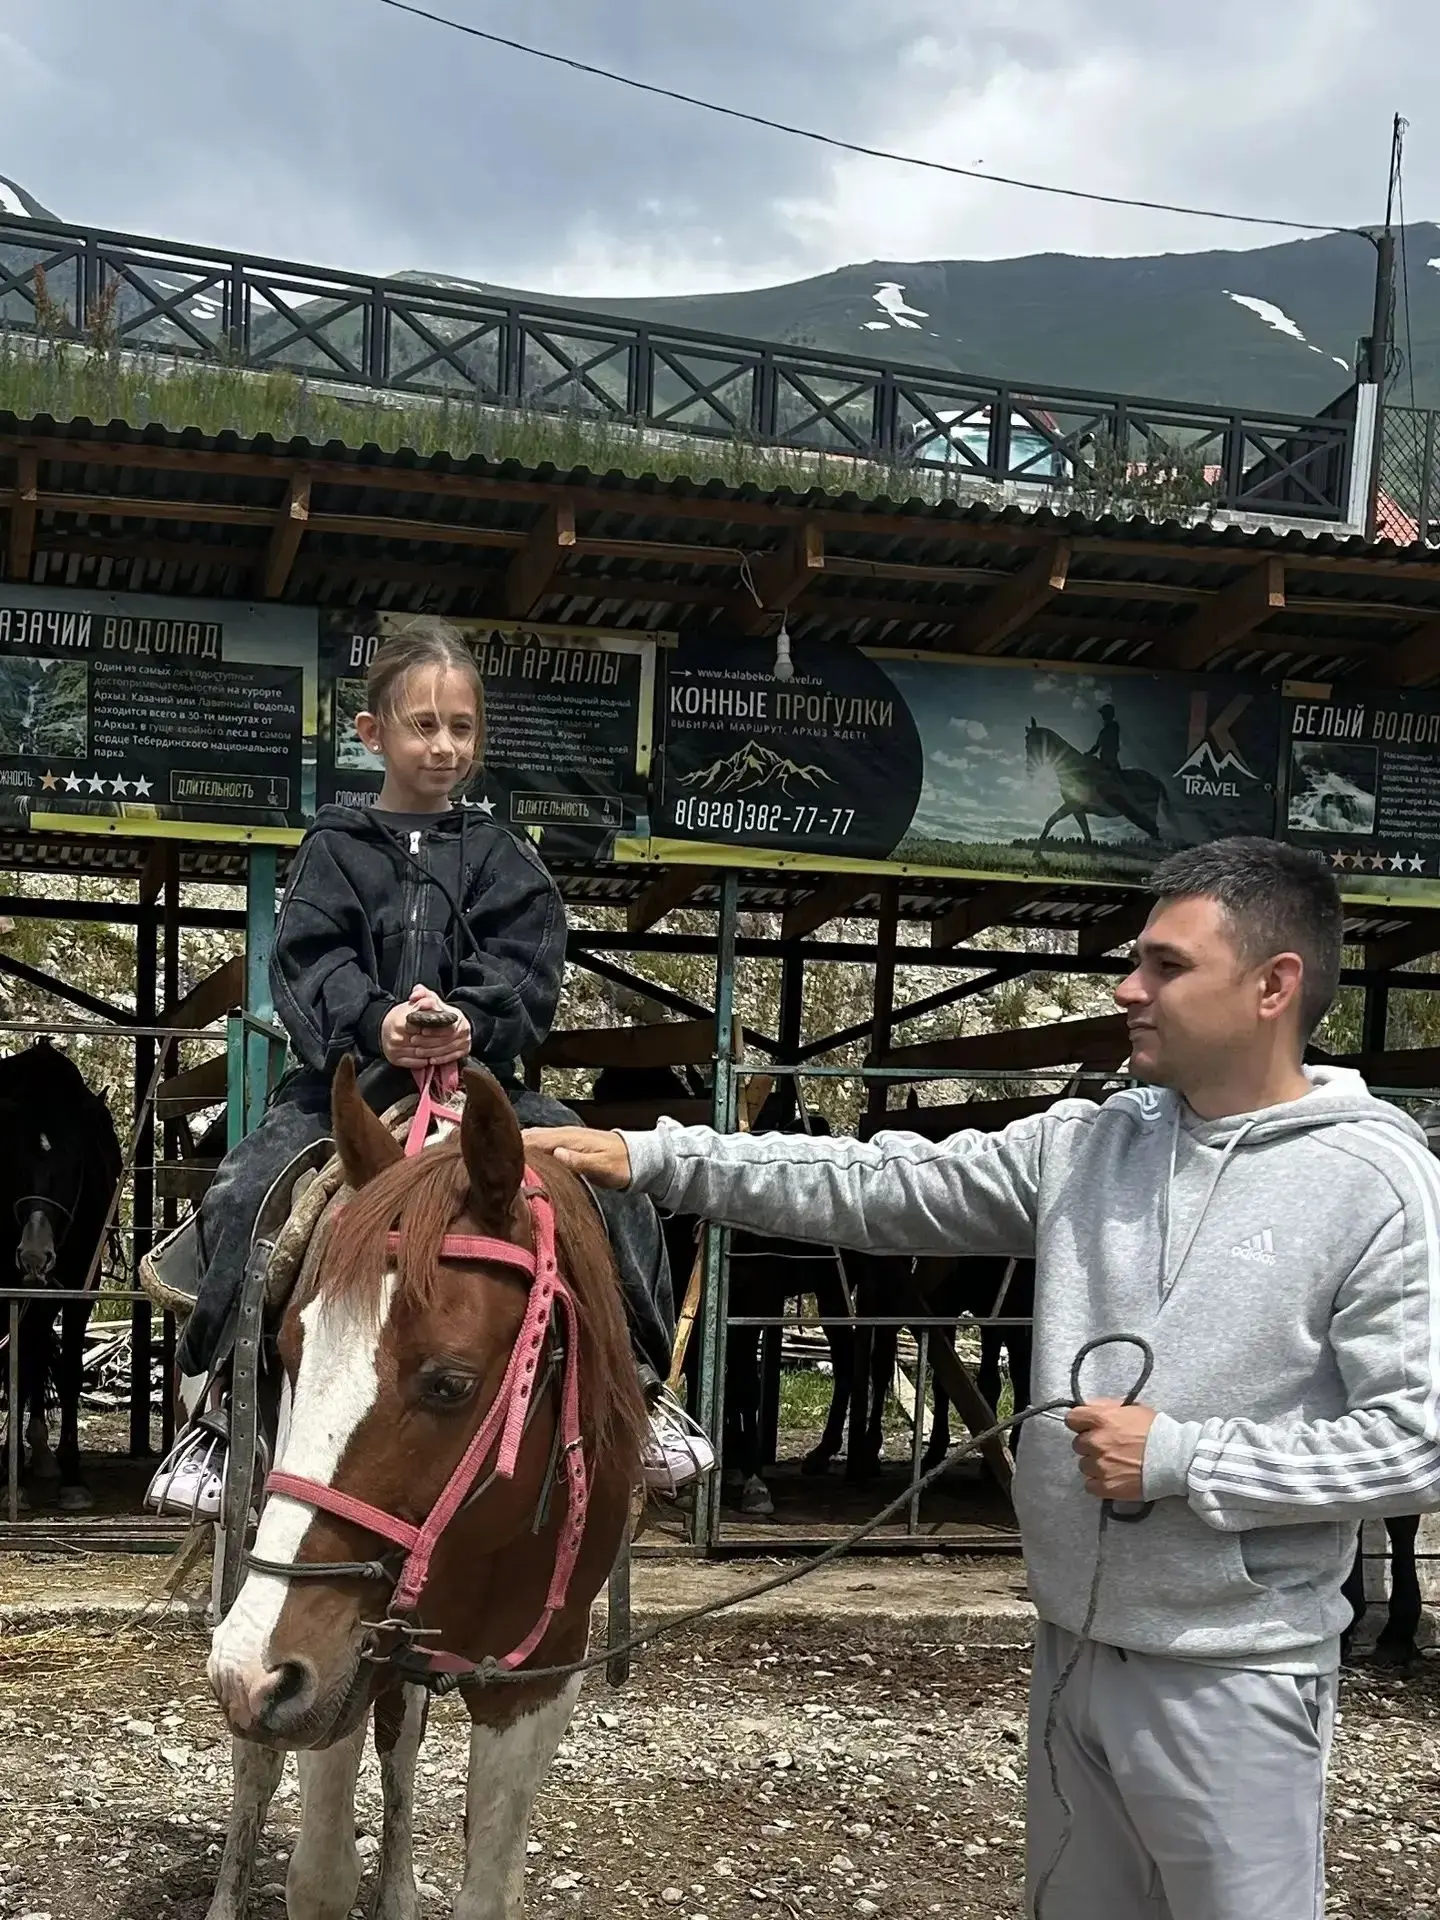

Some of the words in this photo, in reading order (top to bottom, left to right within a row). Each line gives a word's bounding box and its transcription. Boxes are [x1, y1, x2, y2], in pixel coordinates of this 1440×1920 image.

[103, 617, 218, 659] ВОДОПАД
[94, 661, 121, 673] Один
[124, 666, 136, 674] из
[139, 667, 171, 677] самых
[131, 692, 174, 704] Казачий
[176, 697, 197, 706] или
[253, 701, 297, 714] водопад
[227, 686, 241, 695] на
[242, 687, 283, 699] курорте
[93, 706, 148, 718] находится
[149, 709, 177, 720] всего
[179, 711, 186, 719] в
[217, 713, 260, 726] минутах
[261, 716, 274, 725] от
[671, 685, 769, 719] КОННЫЕ
[775, 691, 894, 728] ПРОГУЛКИ
[671, 719, 725, 731] ВЫБИРАЙ
[792, 727, 828, 738] АРХЫЗ
[1292, 703, 1365, 739] БЕЛЫЙ
[140, 723, 148, 732] в
[149, 724, 174, 736] гуще
[176, 725, 225, 737] хвойного
[226, 729, 249, 739] леса
[251, 731, 258, 739] в
[259, 731, 292, 741] самом
[93, 733, 131, 746] сердце
[132, 735, 210, 750] Тебердинского
[211, 741, 290, 755] национального
[177, 778, 255, 799] ДЛИТЕЛЬНОСТЬ
[269, 778, 276, 795] 1
[1181, 774, 1241, 797] TRAVEL
[516, 799, 590, 818] ДЛИТЕЛЬНОСТЬ
[603, 799, 610, 815] 4
[675, 796, 856, 836] 8(928)382-77-77
[1230, 1245, 1276, 1266] adidas
